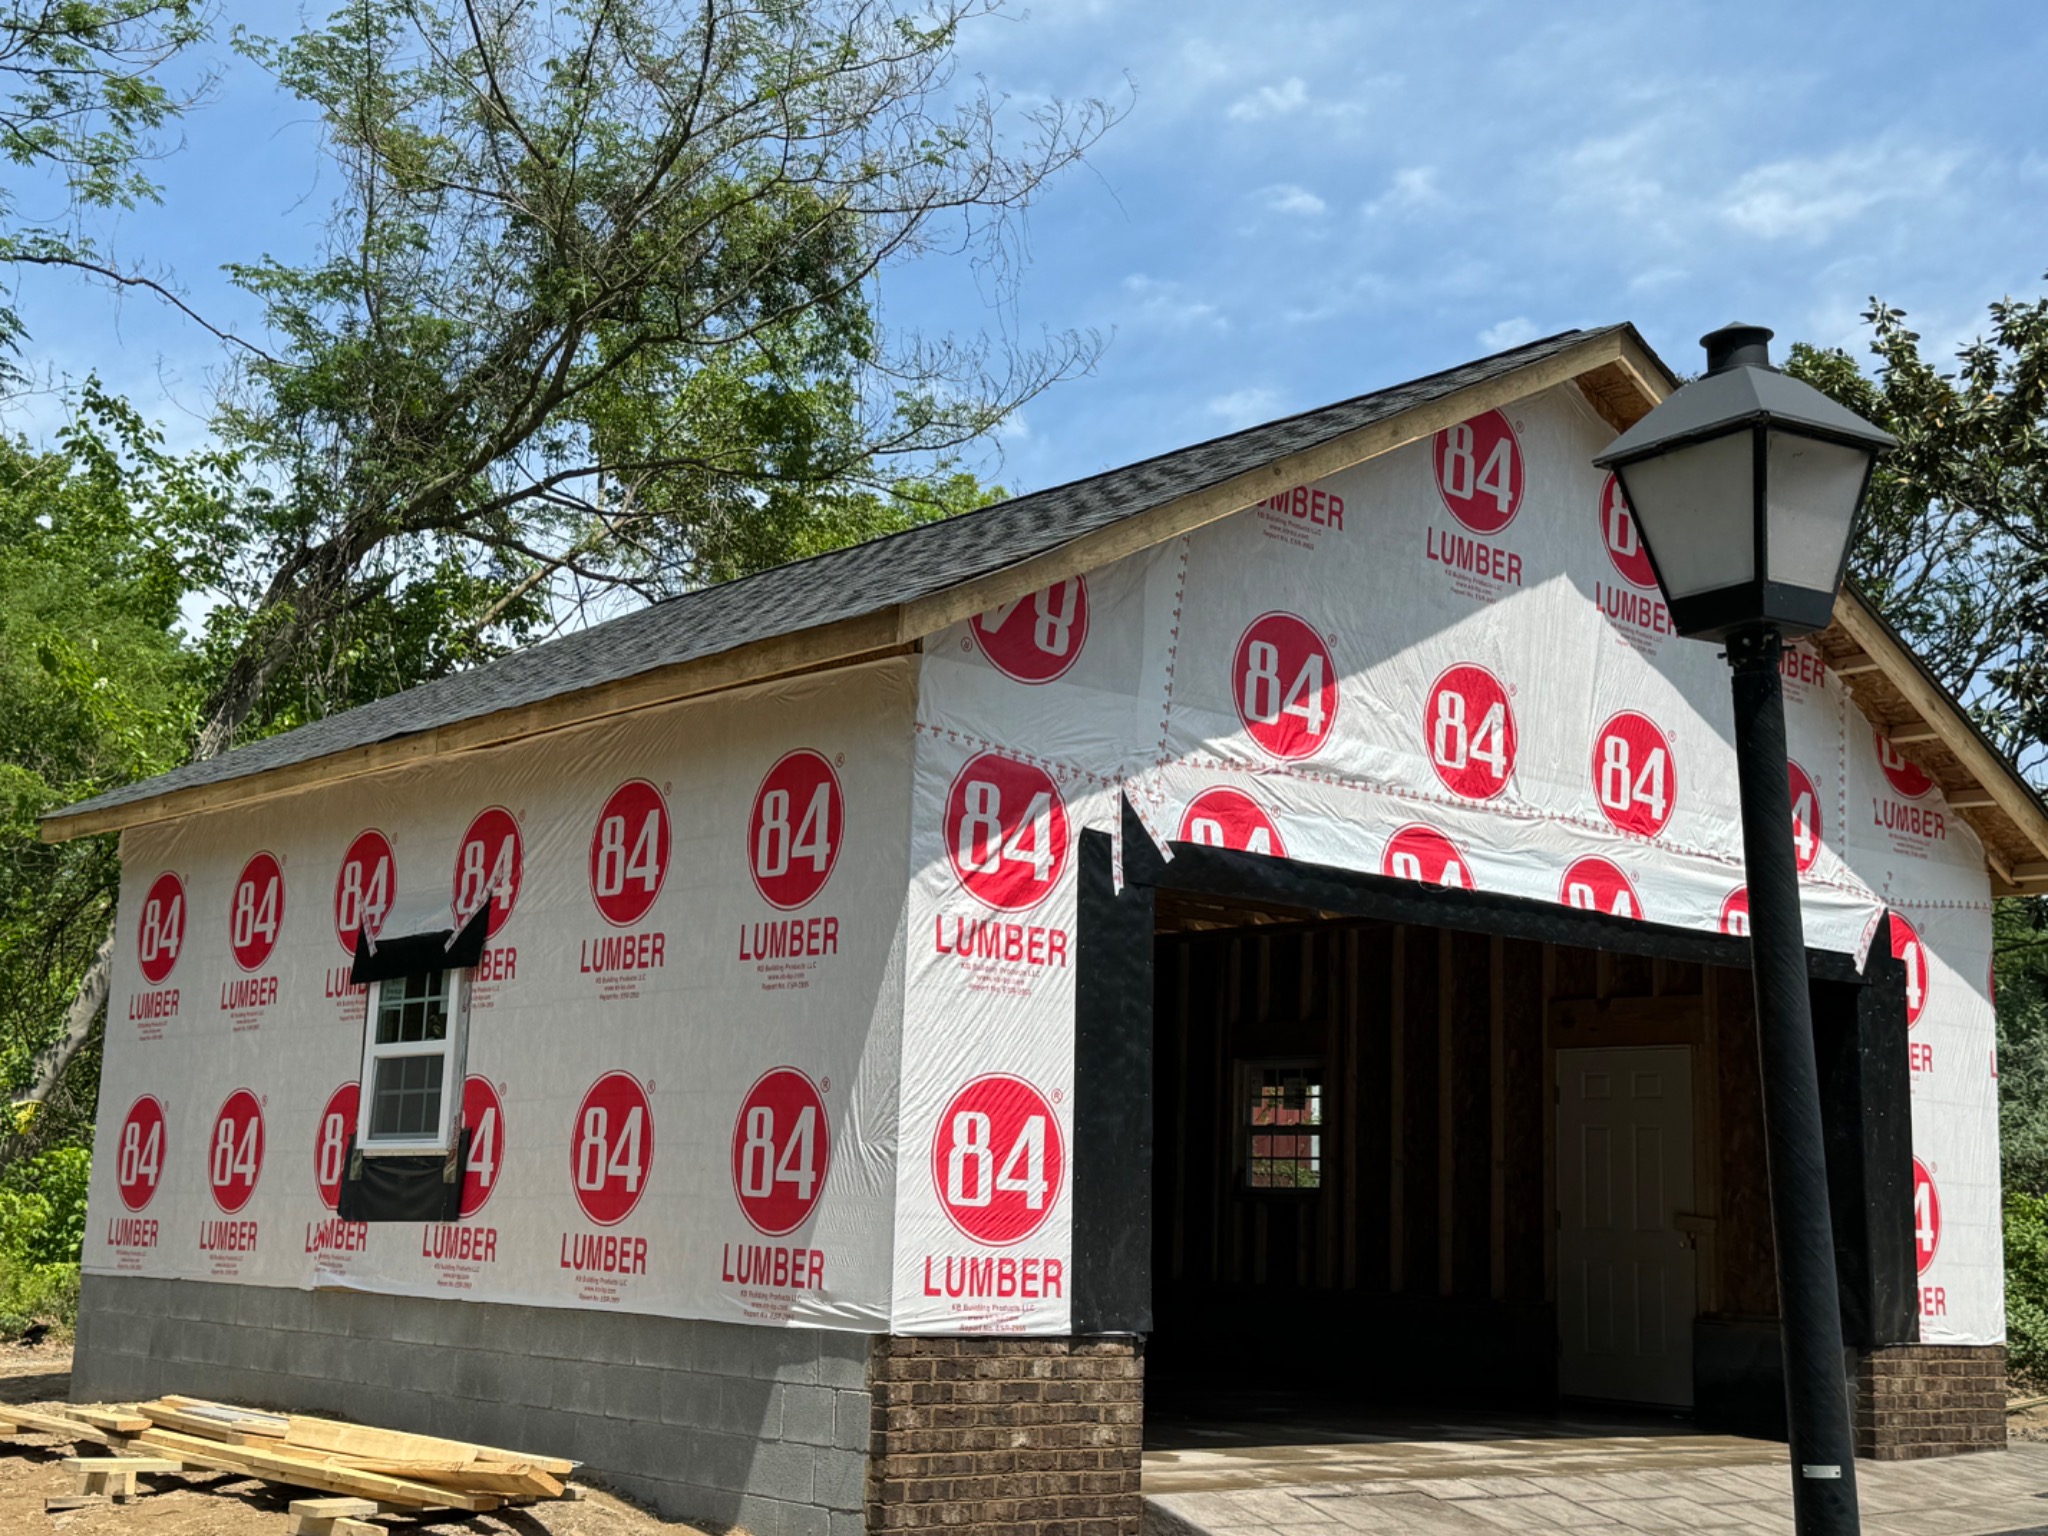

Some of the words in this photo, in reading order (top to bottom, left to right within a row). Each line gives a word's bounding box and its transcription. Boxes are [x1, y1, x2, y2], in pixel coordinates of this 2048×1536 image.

[1443, 423, 1513, 513] 84
[1257, 485, 1344, 531] MBER
[1427, 526, 1522, 587] LUMBER
[1244, 640, 1325, 735] 84
[1778, 650, 1825, 688] BER
[1434, 690, 1507, 779] 84
[1602, 737, 1666, 822] 84
[758, 782, 832, 879] 84
[957, 780, 1055, 881] 84
[1873, 798, 1945, 840] LUMBER
[599, 808, 660, 897] 84
[234, 877, 278, 947] 84
[340, 856, 389, 932] 84
[141, 896, 181, 962] 84
[581, 932, 666, 974] LUMBER
[739, 917, 839, 961] LUMBER
[936, 914, 1067, 967] LUMBER
[221, 976, 278, 1010] LUMBER
[477, 946, 517, 982] BER
[129, 989, 180, 1020] LUMBER
[121, 1121, 162, 1187] 84
[214, 1117, 259, 1188] 84
[320, 1113, 344, 1185] 8
[463, 1107, 496, 1187] 4
[578, 1106, 643, 1193] 84
[742, 1106, 816, 1199] 84
[948, 1111, 1048, 1210] 84
[108, 1217, 158, 1247] LUMBER
[200, 1219, 257, 1251] LUMBER
[423, 1224, 496, 1262] LUMBER
[560, 1233, 647, 1275] LUMBER
[722, 1243, 825, 1291] LUMBER
[924, 1255, 1062, 1298] LUMBER
